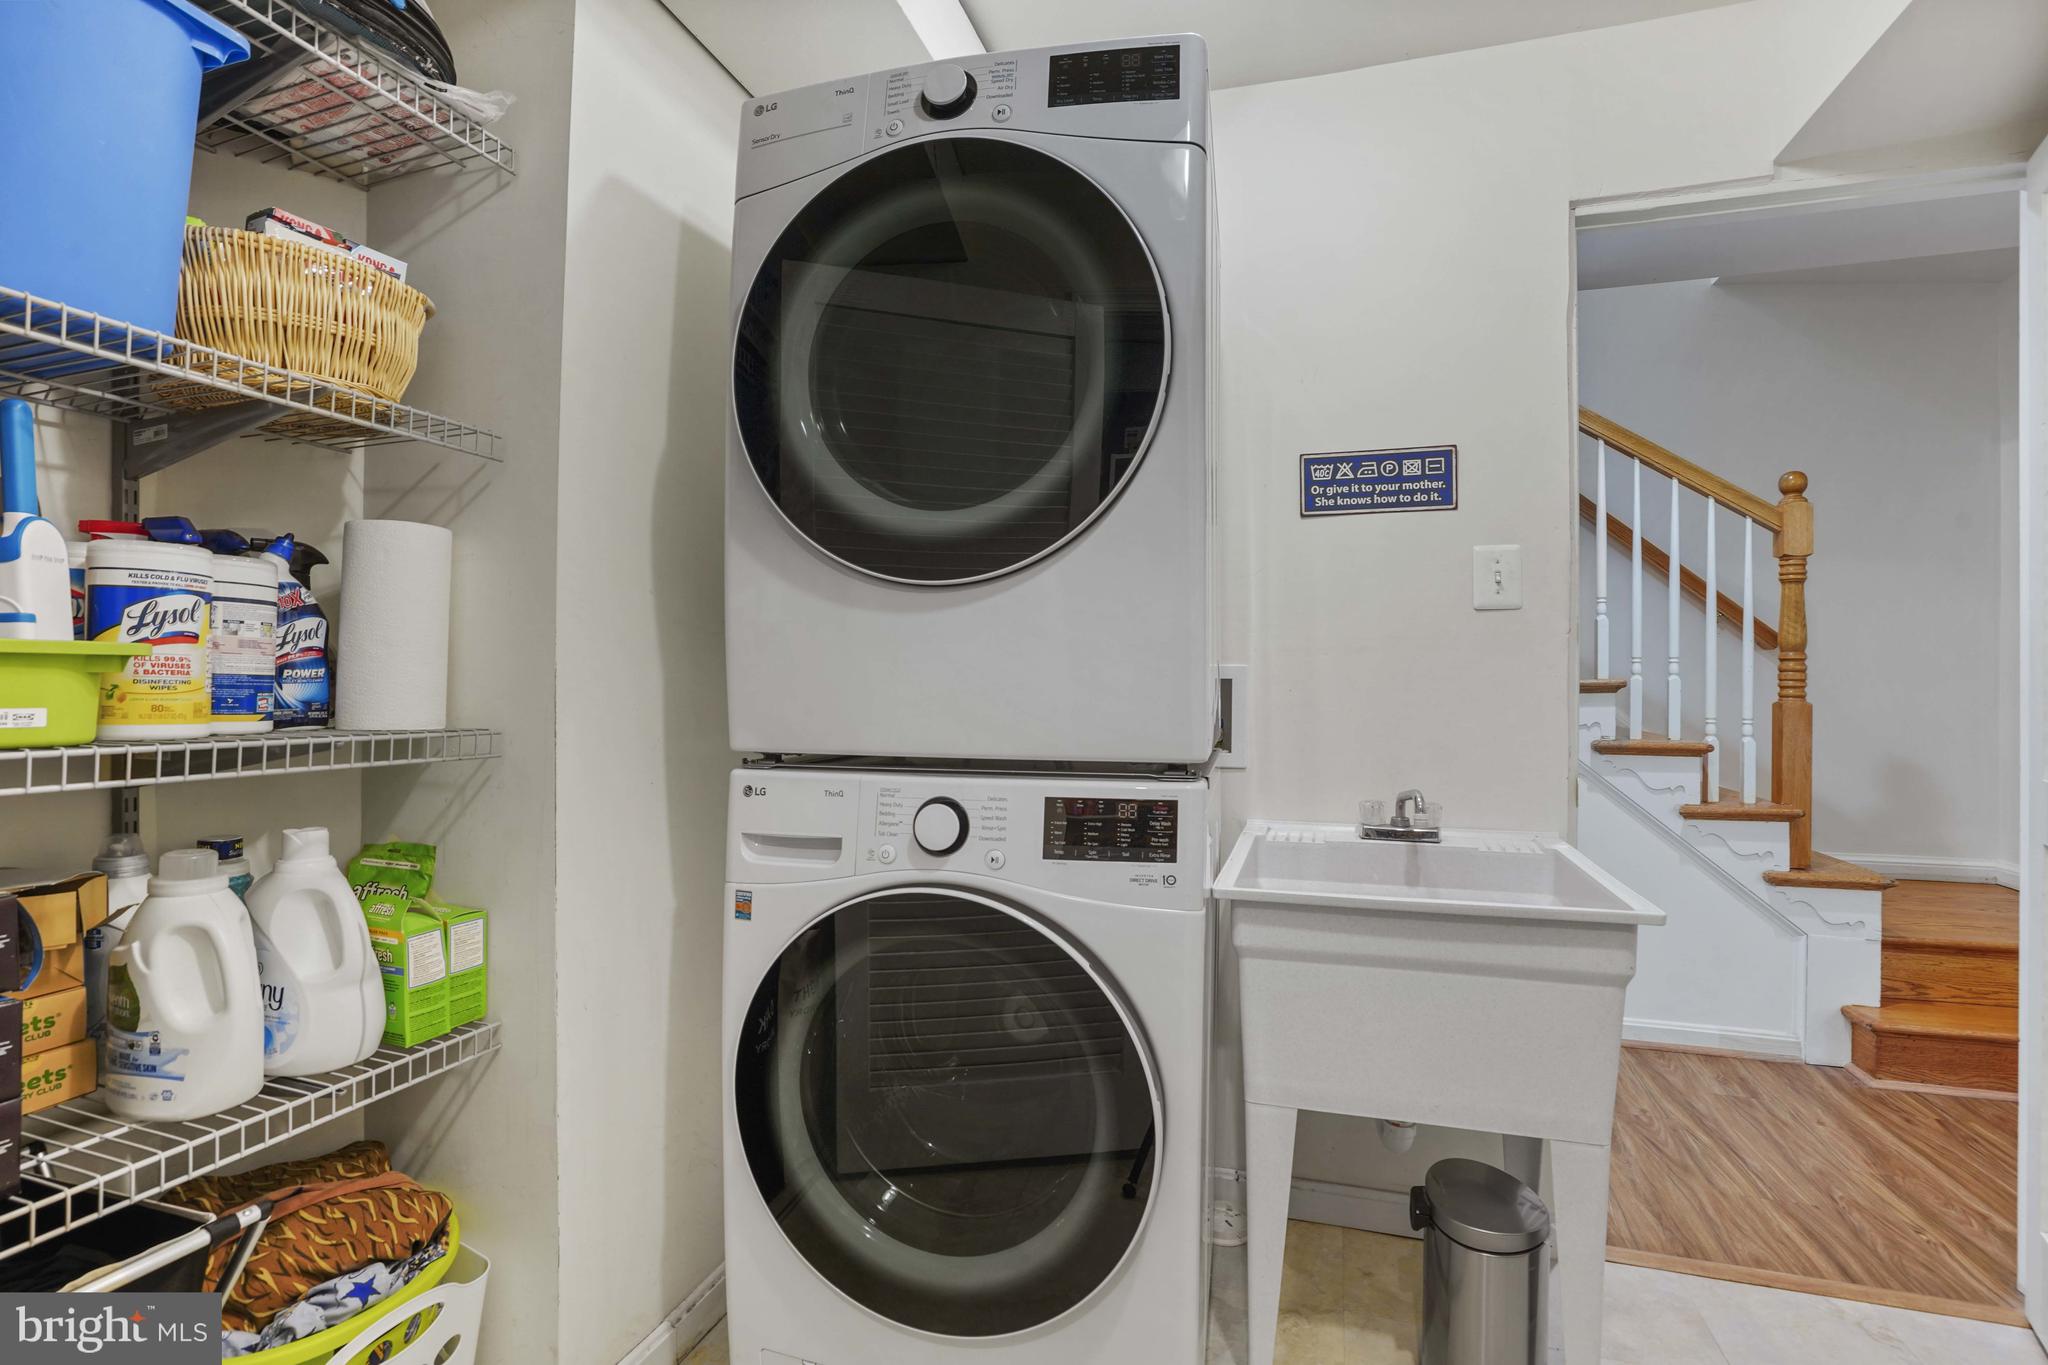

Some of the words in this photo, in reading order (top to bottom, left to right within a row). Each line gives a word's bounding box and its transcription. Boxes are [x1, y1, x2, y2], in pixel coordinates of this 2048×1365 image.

[834, 86, 855, 97] ThinQ
[765, 102, 778, 113] LG
[1310, 485, 1325, 495] Or
[1326, 484, 1350, 496] give
[1351, 482, 1360, 493] it
[1361, 483, 1373, 493] to
[1374, 482, 1400, 494] your
[1402, 479, 1446, 491] mother.
[1314, 497, 1335, 507] She
[1336, 496, 1372, 506] knows
[1373, 494, 1398, 504] how
[1399, 494, 1412, 503] to
[1412, 492, 1429, 502] do
[1430, 491, 1443, 501] it.
[128, 572, 149, 580] KILLS
[126, 598, 201, 637] Lysol
[276, 620, 322, 652] Lysol
[283, 668, 326, 679] POWER
[151, 704, 164, 713] 80
[754, 787, 767, 797] LG
[824, 790, 844, 798] ThinQ
[368, 903, 396, 916] affresh
[24, 1030, 51, 1042] CLUB
[142, 1064, 157, 1073] SKIN
[36, 1083, 62, 1096] CLUB
